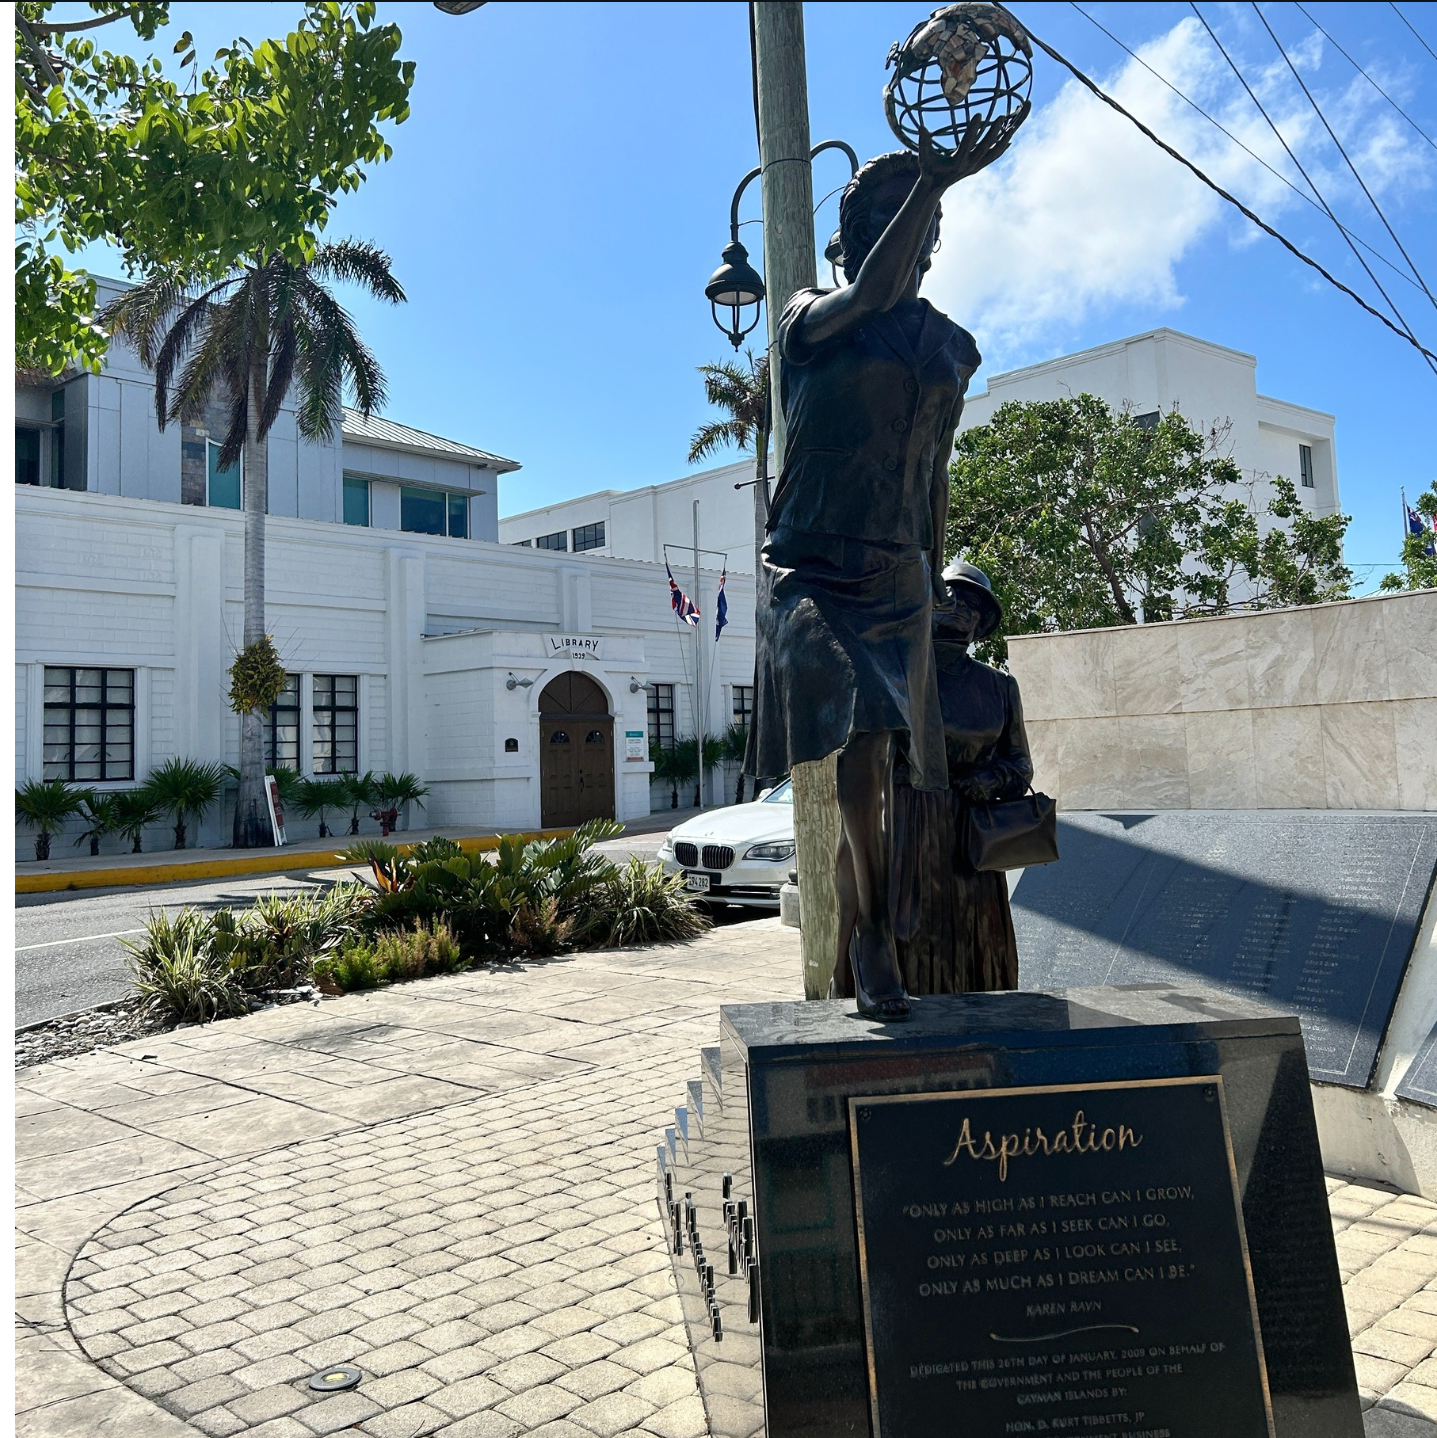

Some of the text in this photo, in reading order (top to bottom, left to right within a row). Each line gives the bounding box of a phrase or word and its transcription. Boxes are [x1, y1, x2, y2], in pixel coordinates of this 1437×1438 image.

[551, 637, 599, 652] LIBRARY
[944, 1109, 1144, 1183] Aspiration
[952, 1201, 970, 1216] AS
[975, 1198, 1014, 1214] HIGH
[1018, 1196, 1036, 1211] AS
[1050, 1192, 1096, 1208] REACH
[1101, 1189, 1132, 1205] CAN
[1145, 1186, 1195, 1201] GROW,
[933, 1227, 972, 1243] ONLY
[977, 1225, 995, 1240] AS
[1000, 1222, 1026, 1238] FAR
[1031, 1221, 1048, 1235] AS
[1061, 1218, 1094, 1233] SEEK
[1098, 1215, 1129, 1231] CAN
[926, 1253, 966, 1269] ONLY
[971, 1252, 988, 1267] AS
[993, 1249, 1029, 1265] DEEP
[1033, 1247, 1051, 1262] AS
[1064, 1244, 1106, 1260] LOOK
[1110, 1242, 1141, 1257] CAN
[919, 1281, 958, 1297] ONLY
[963, 1278, 981, 1294] AS
[986, 1275, 1032, 1291] MUCH
[1036, 1273, 1054, 1289] AS
[1068, 1270, 1120, 1286] DREAM
[1124, 1267, 1155, 1282] CAN
[1026, 1299, 1103, 1317] KAREN RAVN
[909, 1361, 969, 1378] DEDICATED
[971, 1358, 996, 1372] THIS
[998, 1356, 1025, 1370] 26TH
[1028, 1354, 1049, 1367] DAY
[1052, 1353, 1066, 1365] OF
[1121, 1347, 1146, 1360] 2009
[1148, 1346, 1166, 1358] ON
[1169, 1343, 1207, 1356] BEHALF
[1210, 1341, 1226, 1353] OF
[956, 1362, 1184, 1391] THE GOVERNMENT AND THE PEOPLE OF THE
[1016, 1390, 1062, 1405] CAYMAN
[1065, 1387, 1109, 1401] ISLANDS
[1005, 1420, 1035, 1433] HON.
[1052, 1417, 1080, 1430] KURT
